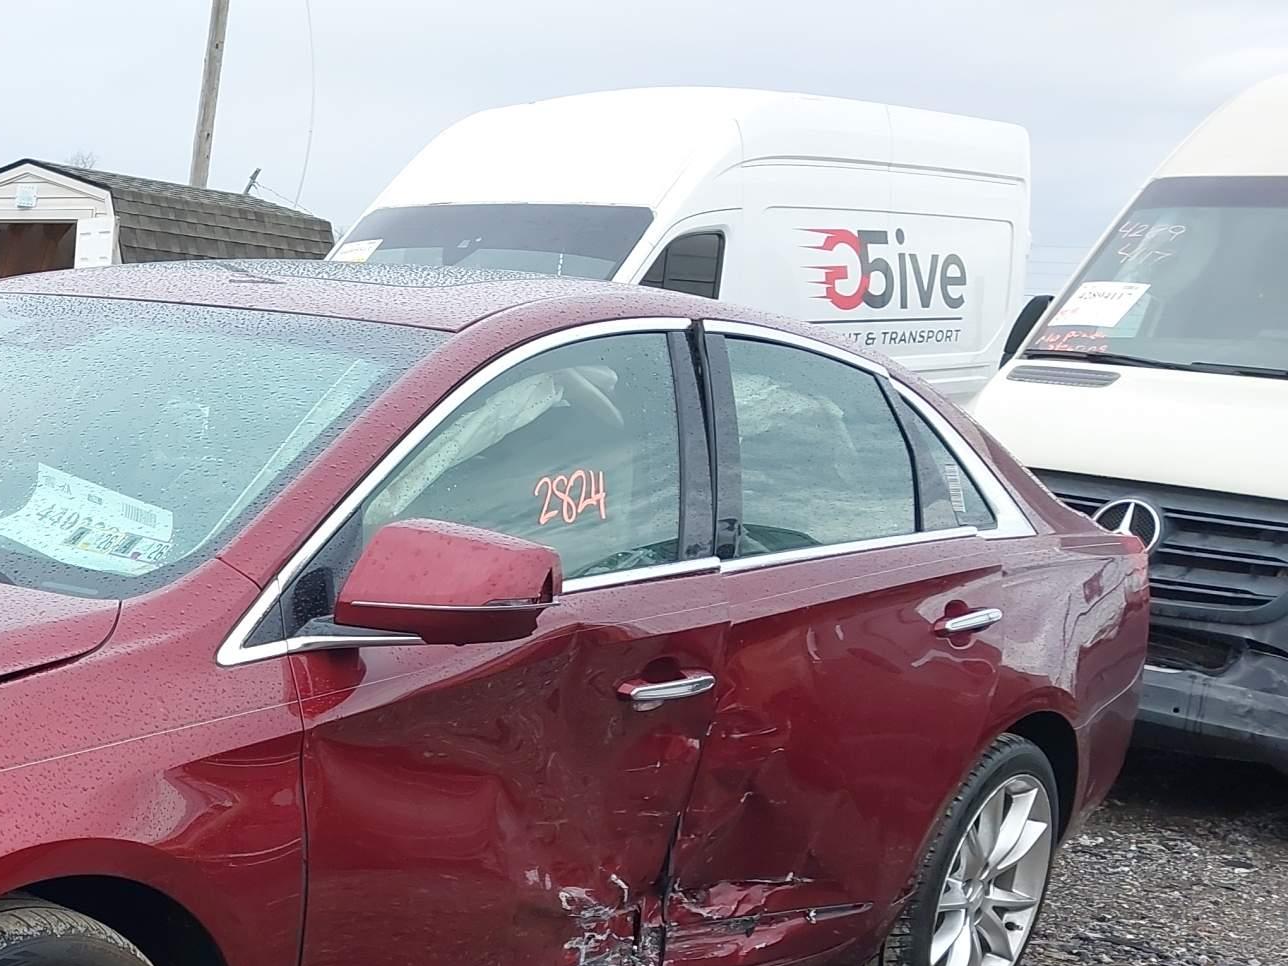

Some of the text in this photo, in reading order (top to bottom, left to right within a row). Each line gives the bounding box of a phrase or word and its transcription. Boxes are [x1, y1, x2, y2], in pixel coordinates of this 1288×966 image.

[865, 331, 877, 346] &
[881, 329, 962, 345] TRANSPORT
[534, 469, 607, 525] 2824
